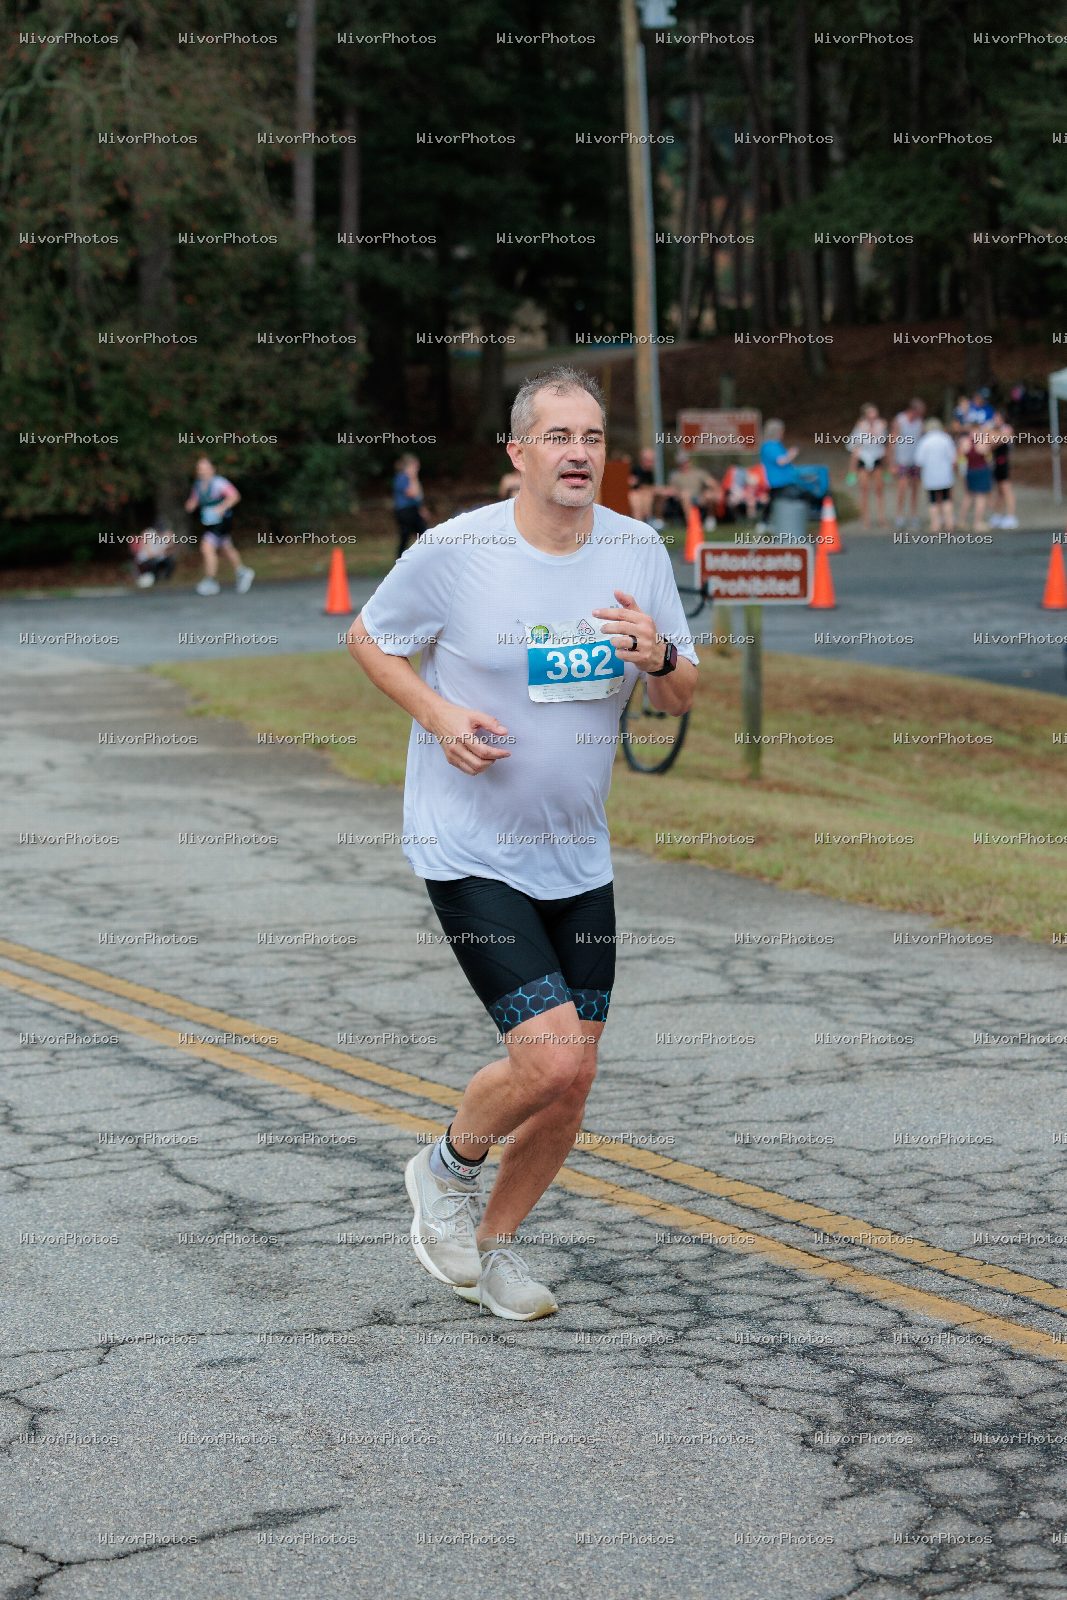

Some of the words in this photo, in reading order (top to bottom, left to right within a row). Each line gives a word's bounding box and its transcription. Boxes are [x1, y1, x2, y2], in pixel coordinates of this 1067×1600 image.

[705, 552, 802, 571] Intoxicants
[708, 575, 800, 596] Prohibited
[547, 645, 613, 680] 382
